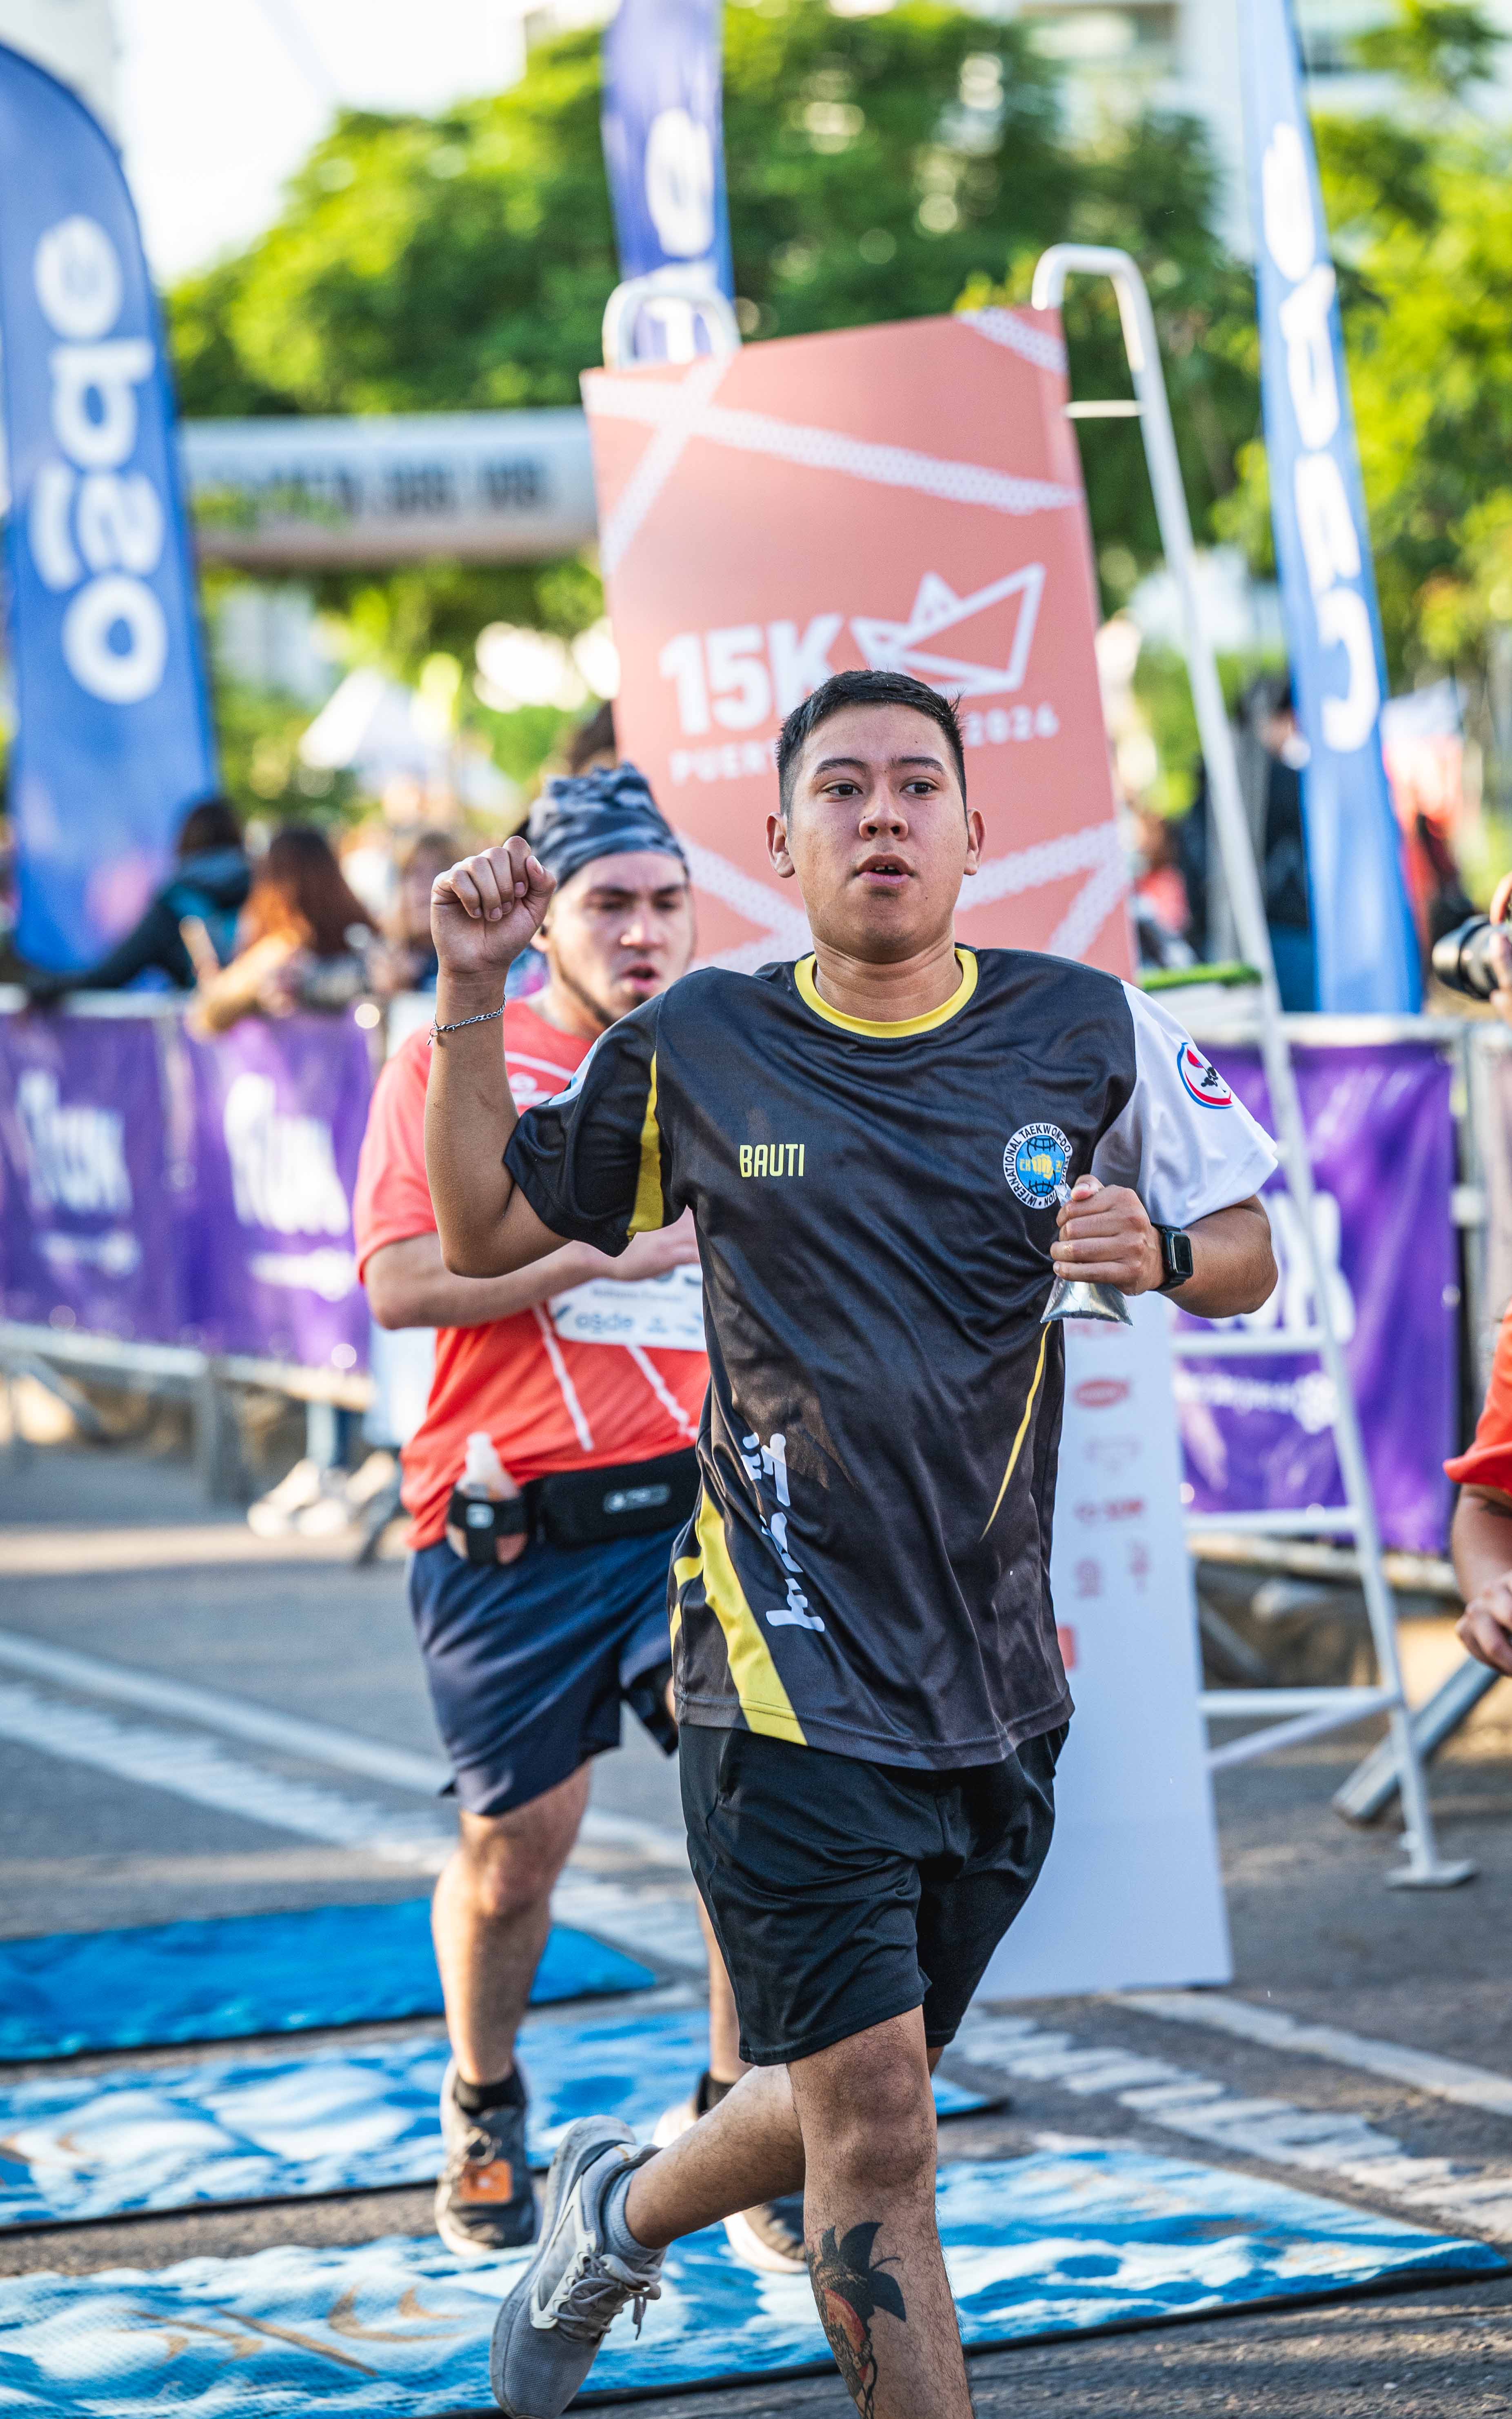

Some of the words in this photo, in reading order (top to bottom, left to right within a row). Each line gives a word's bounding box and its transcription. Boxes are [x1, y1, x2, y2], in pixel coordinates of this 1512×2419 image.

[659, 613, 843, 736] 15K
[964, 701, 1060, 748] 2026
[739, 1143, 805, 1178] BAUTI
[1018, 1124, 1071, 1153] TAEKWON-DO
[1005, 1137, 1038, 1207] INTERNATIONAL
